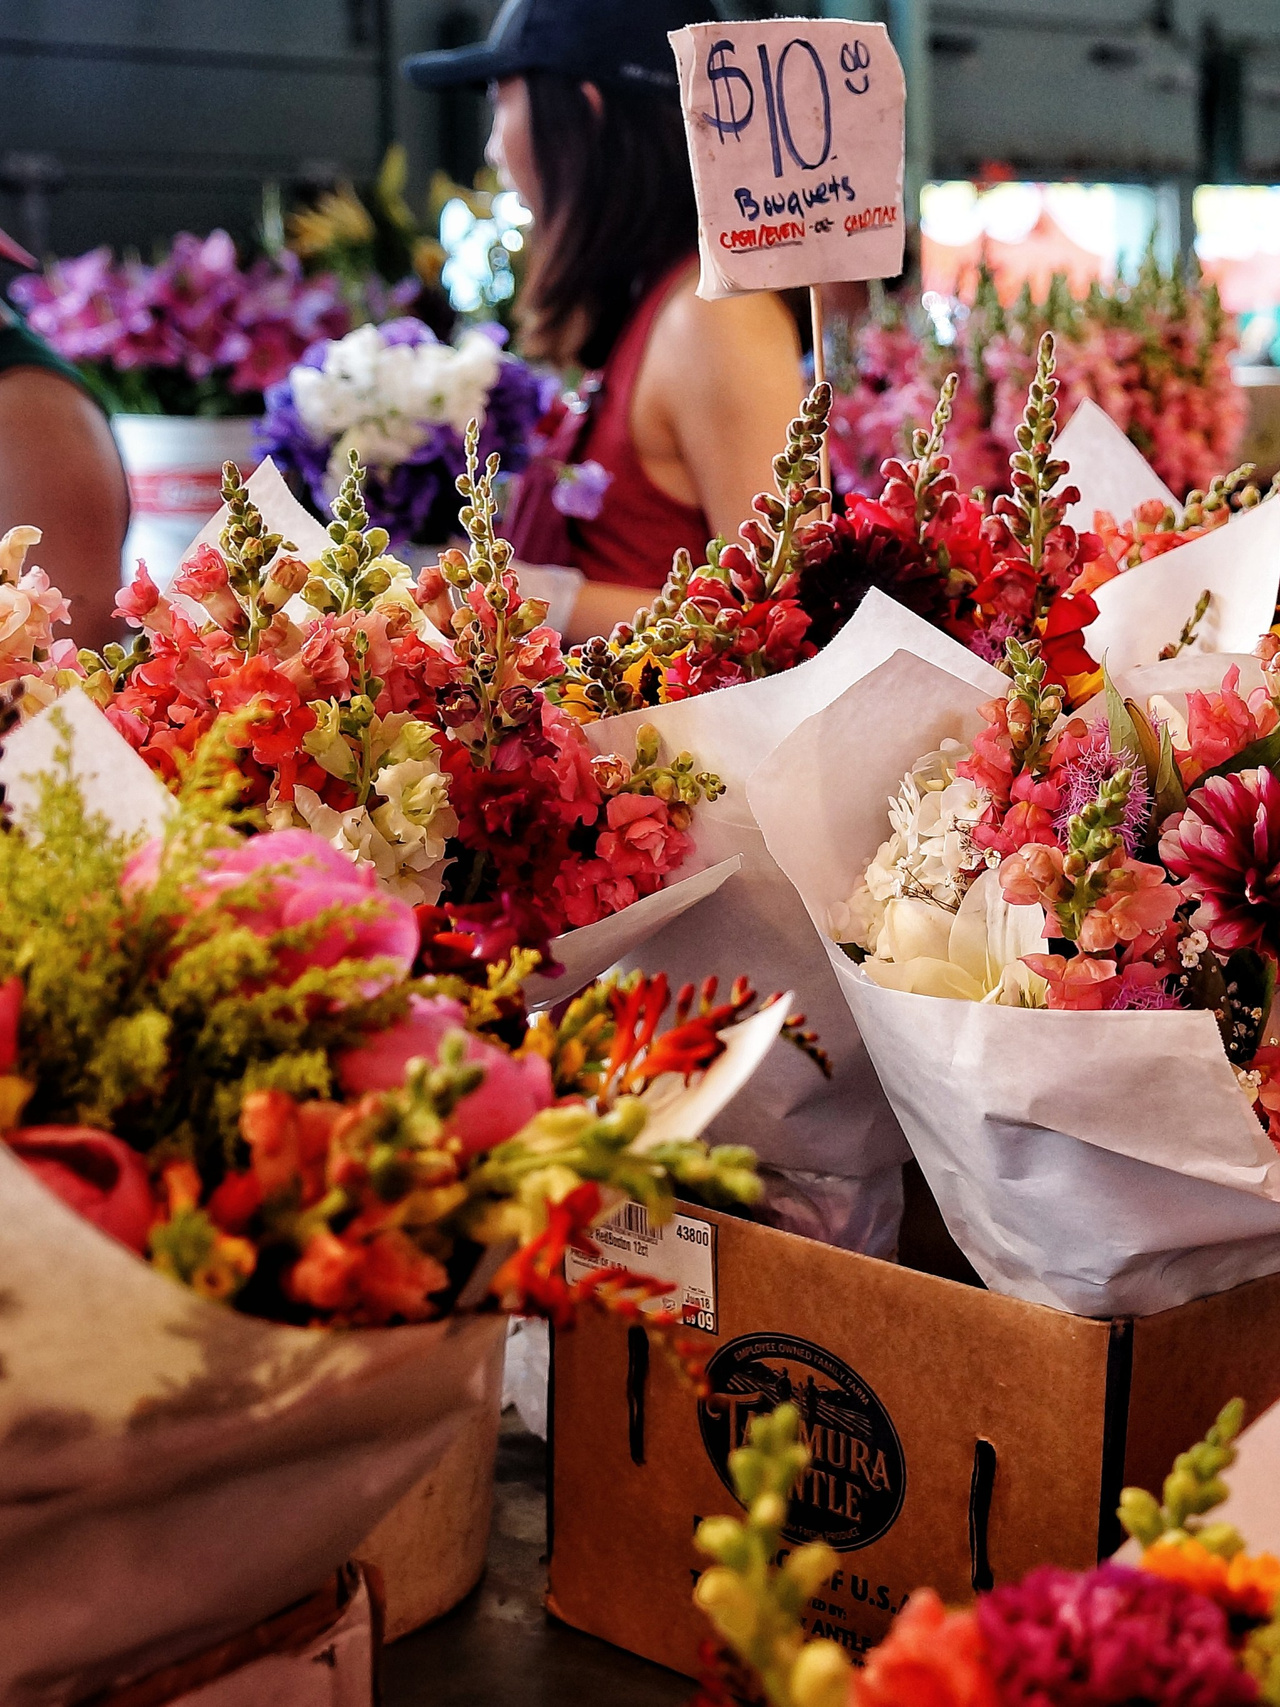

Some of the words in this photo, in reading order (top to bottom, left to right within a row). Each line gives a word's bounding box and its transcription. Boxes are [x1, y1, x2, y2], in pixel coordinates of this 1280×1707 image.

[734, 175, 856, 221] Bouquets
[676, 1224, 709, 1247] 43800
[698, 1311, 714, 1331] 09
[733, 1342, 777, 1362] EMPLOYEE
[778, 1343, 812, 1360] OWNED
[813, 1354, 846, 1381] FAMILY
[844, 1377, 870, 1406] FARM
[788, 1467, 862, 1524] NTLE
